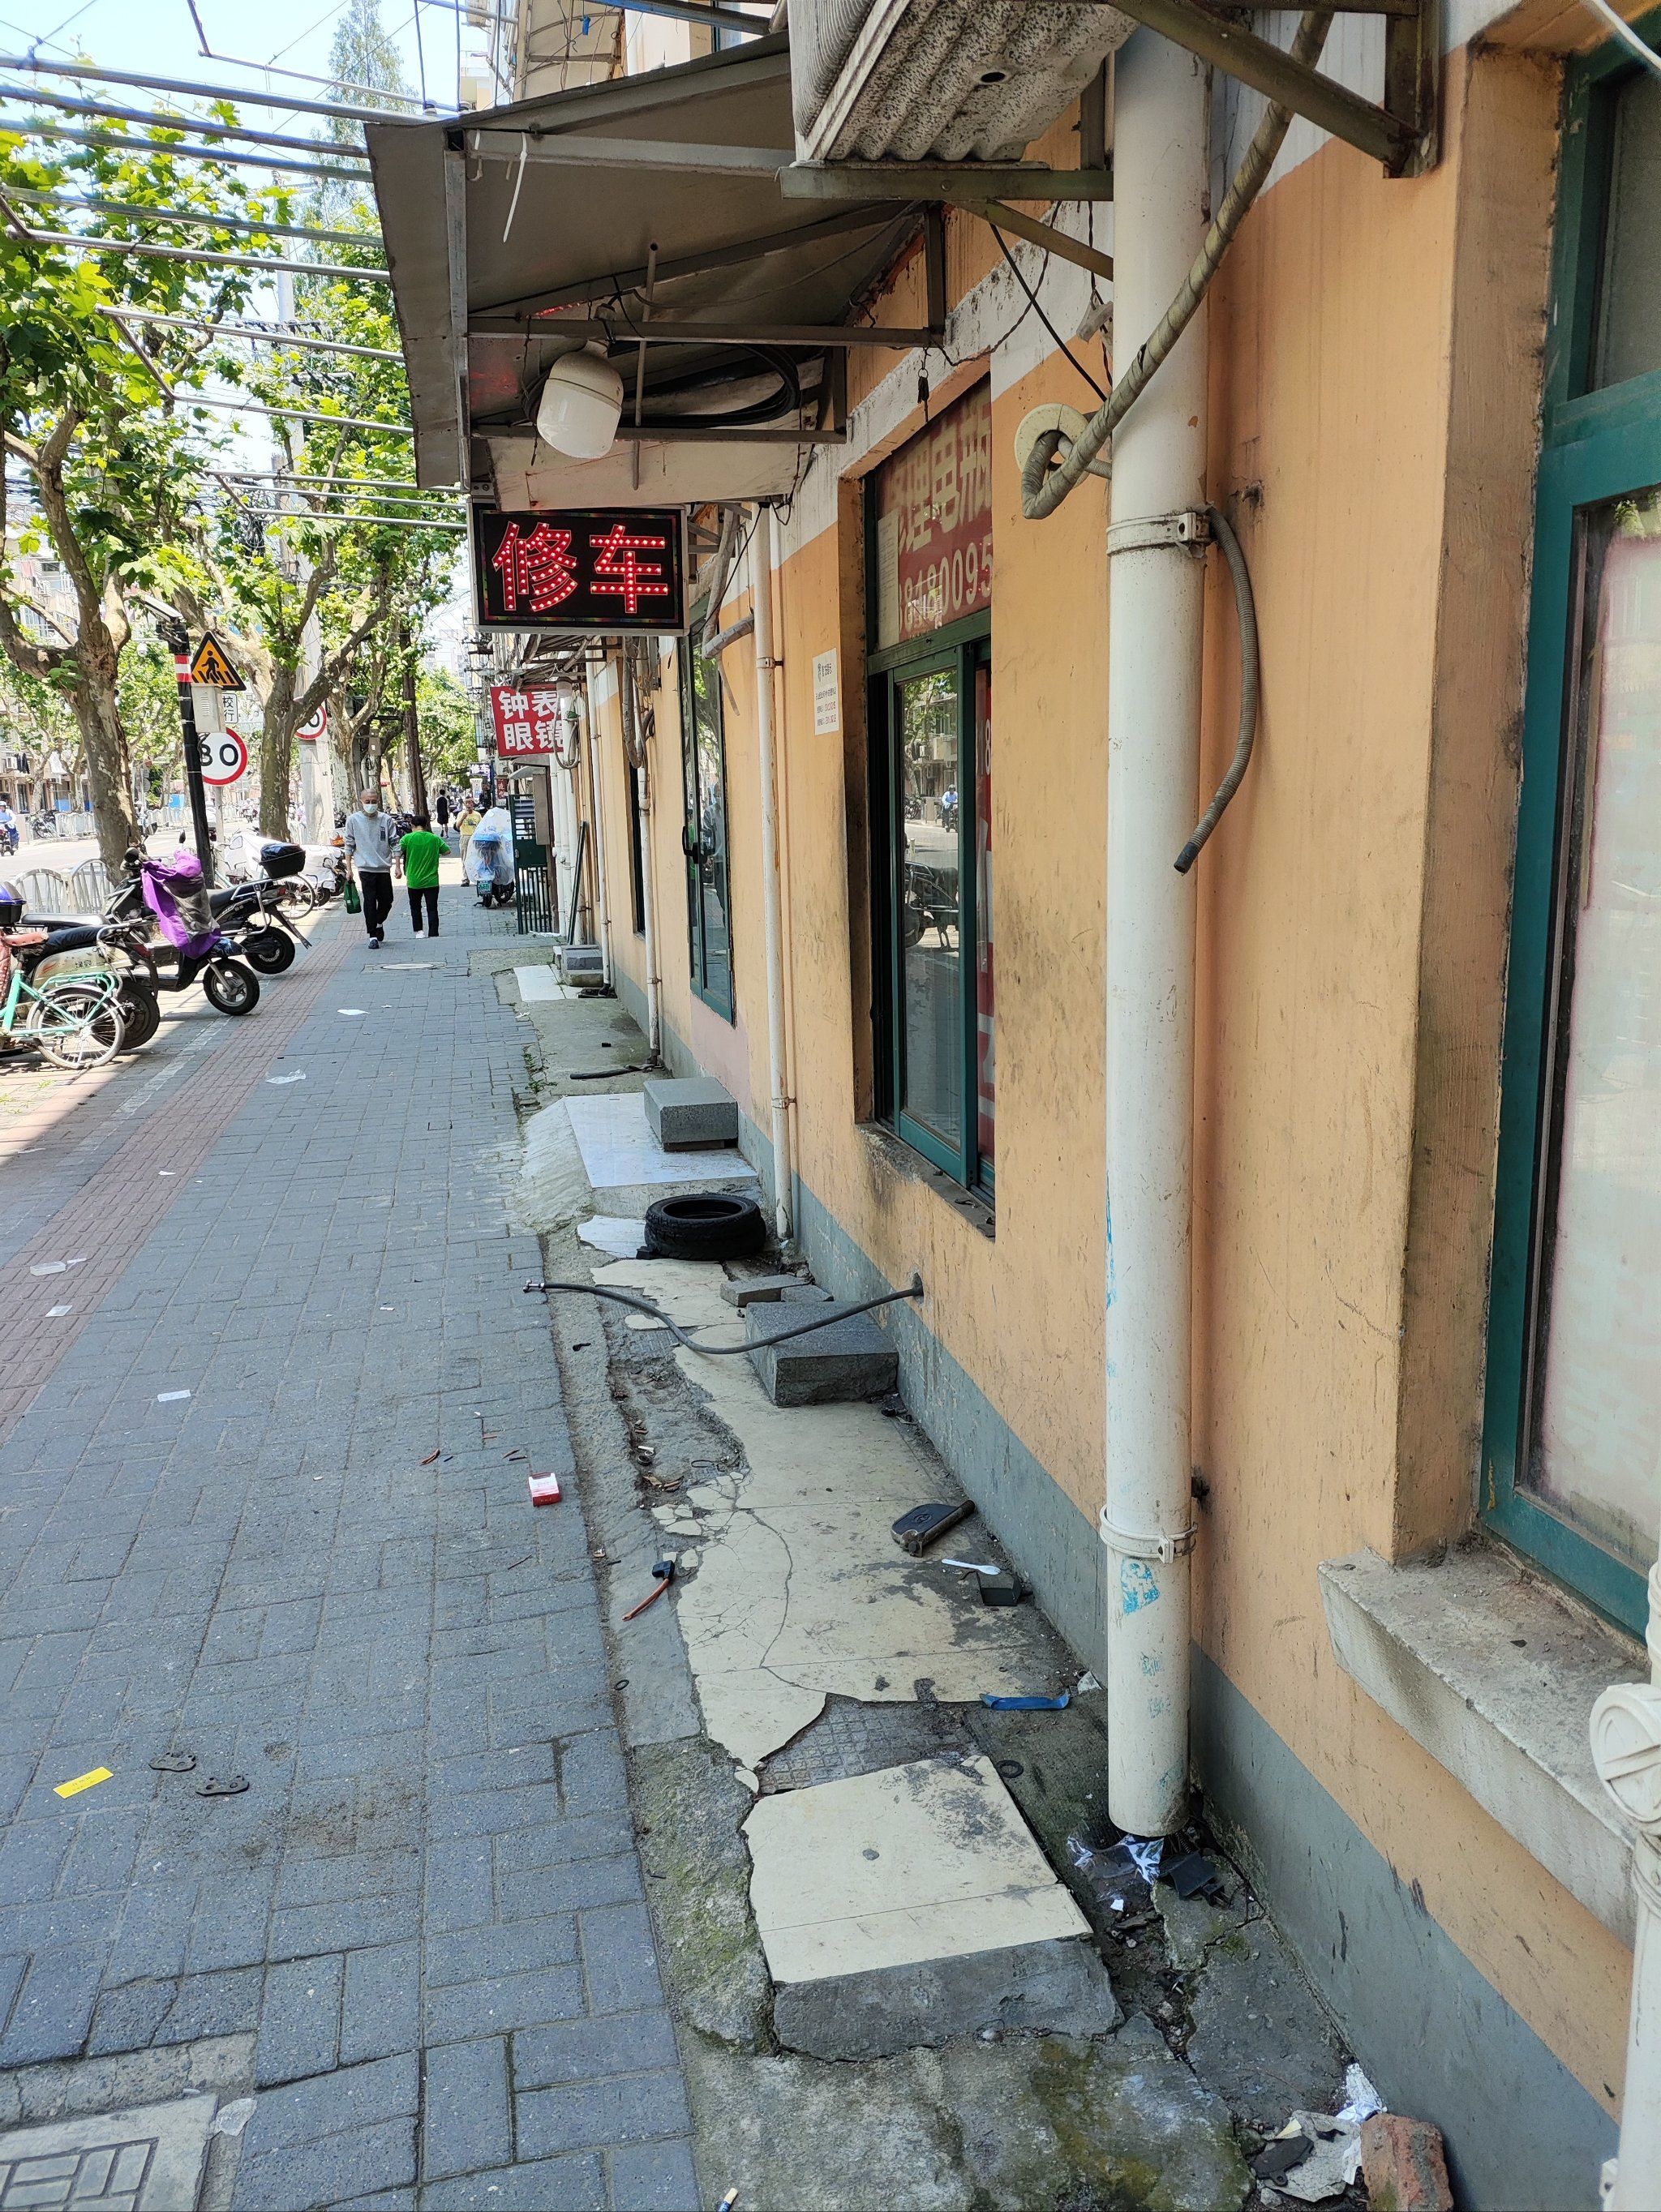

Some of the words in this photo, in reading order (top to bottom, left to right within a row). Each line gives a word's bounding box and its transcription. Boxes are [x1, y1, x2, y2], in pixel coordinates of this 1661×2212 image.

[491, 521, 667, 613] 修车
[498, 691, 560, 720] 钟表
[503, 720, 564, 751] 眼镜
